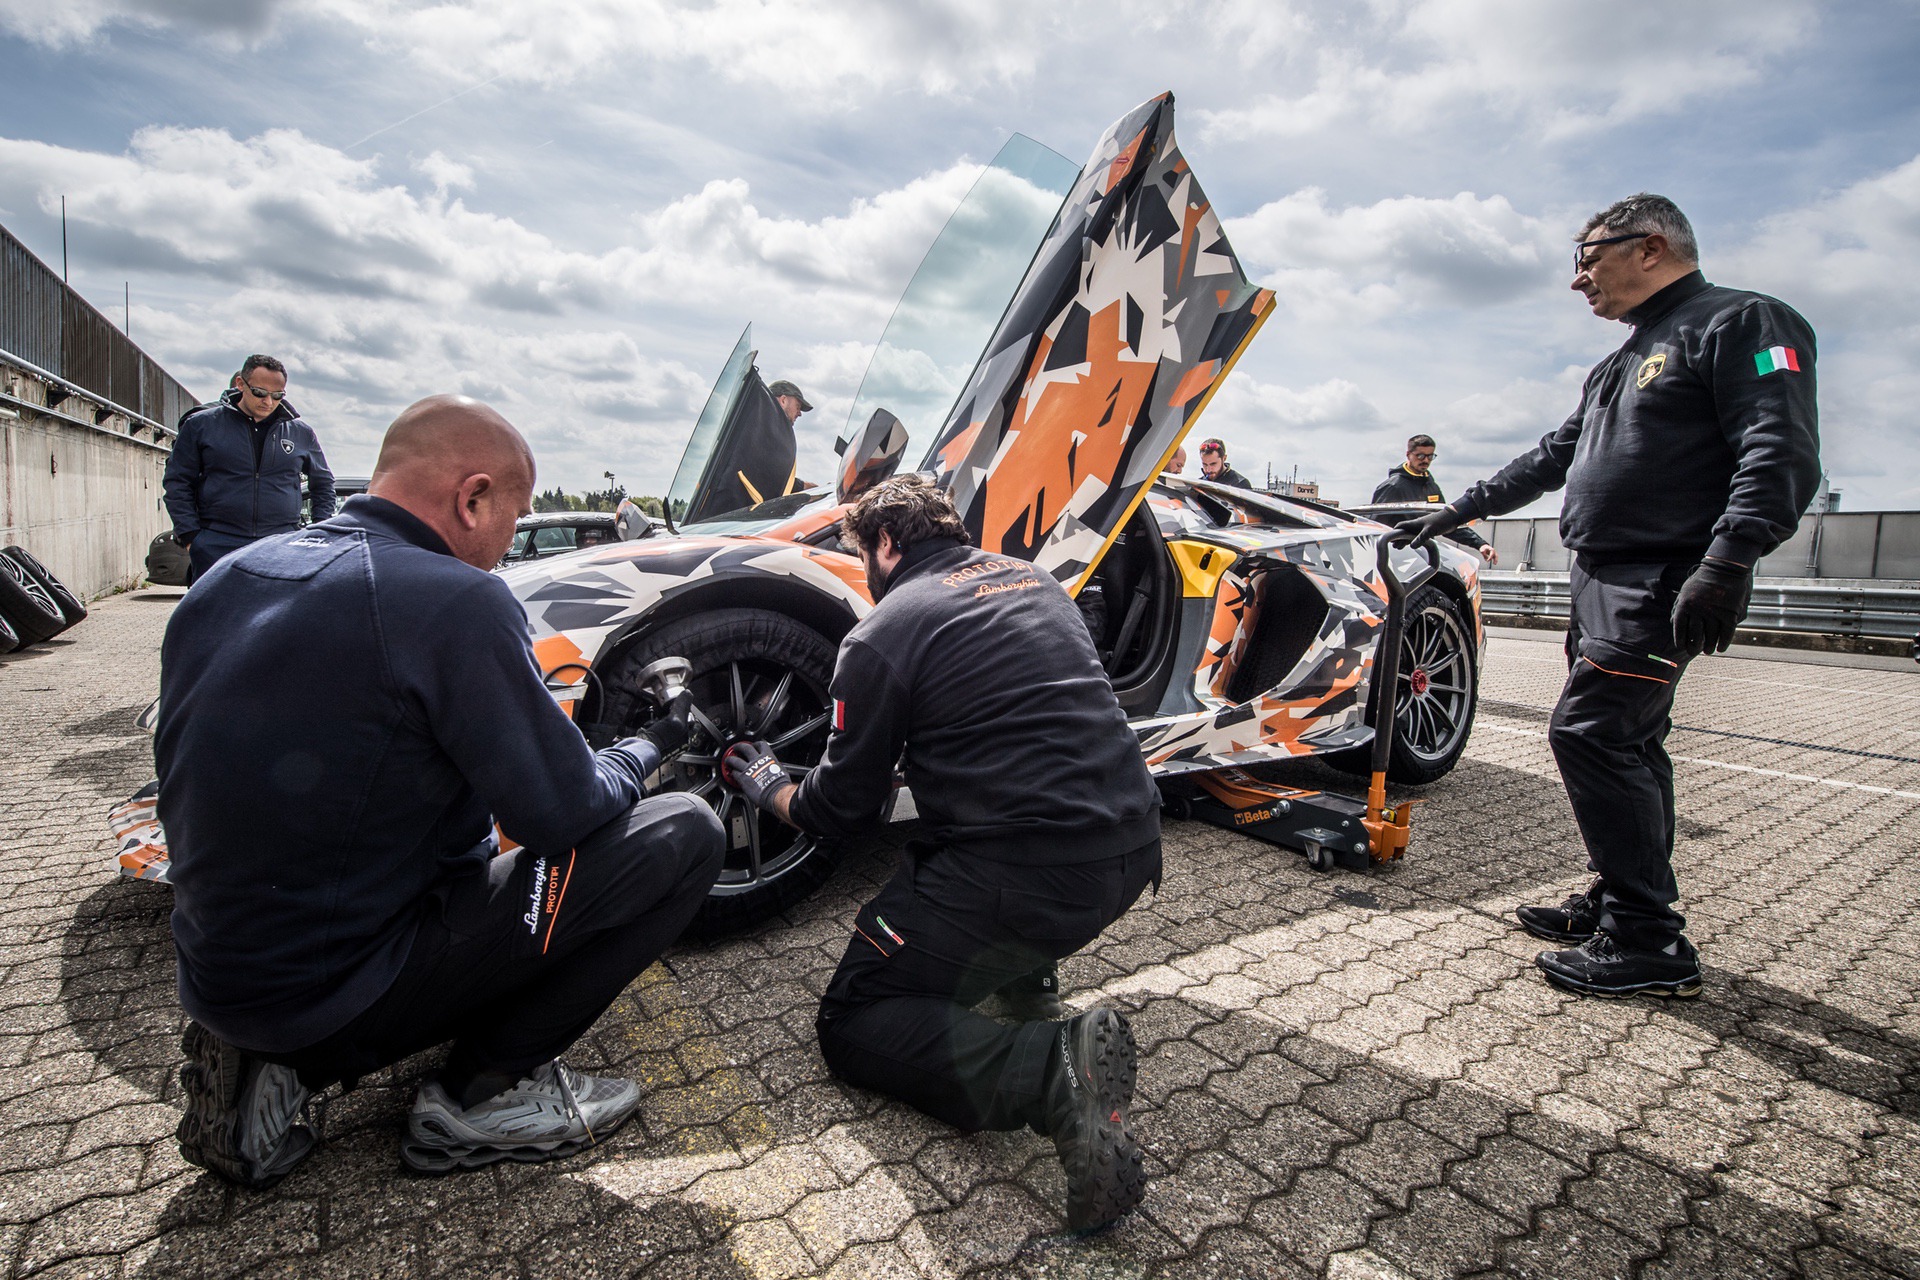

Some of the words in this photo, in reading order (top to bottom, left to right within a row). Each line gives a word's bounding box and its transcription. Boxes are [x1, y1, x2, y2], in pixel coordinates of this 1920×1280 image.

[942, 560, 1034, 588] PROTOTIPI
[974, 579, 1041, 598] Lamborghini
[745, 755, 772, 776] uvex
[1243, 809, 1271, 824] Beta
[523, 857, 547, 935] Lamborghin
[545, 866, 560, 914] PROTOTIPI
